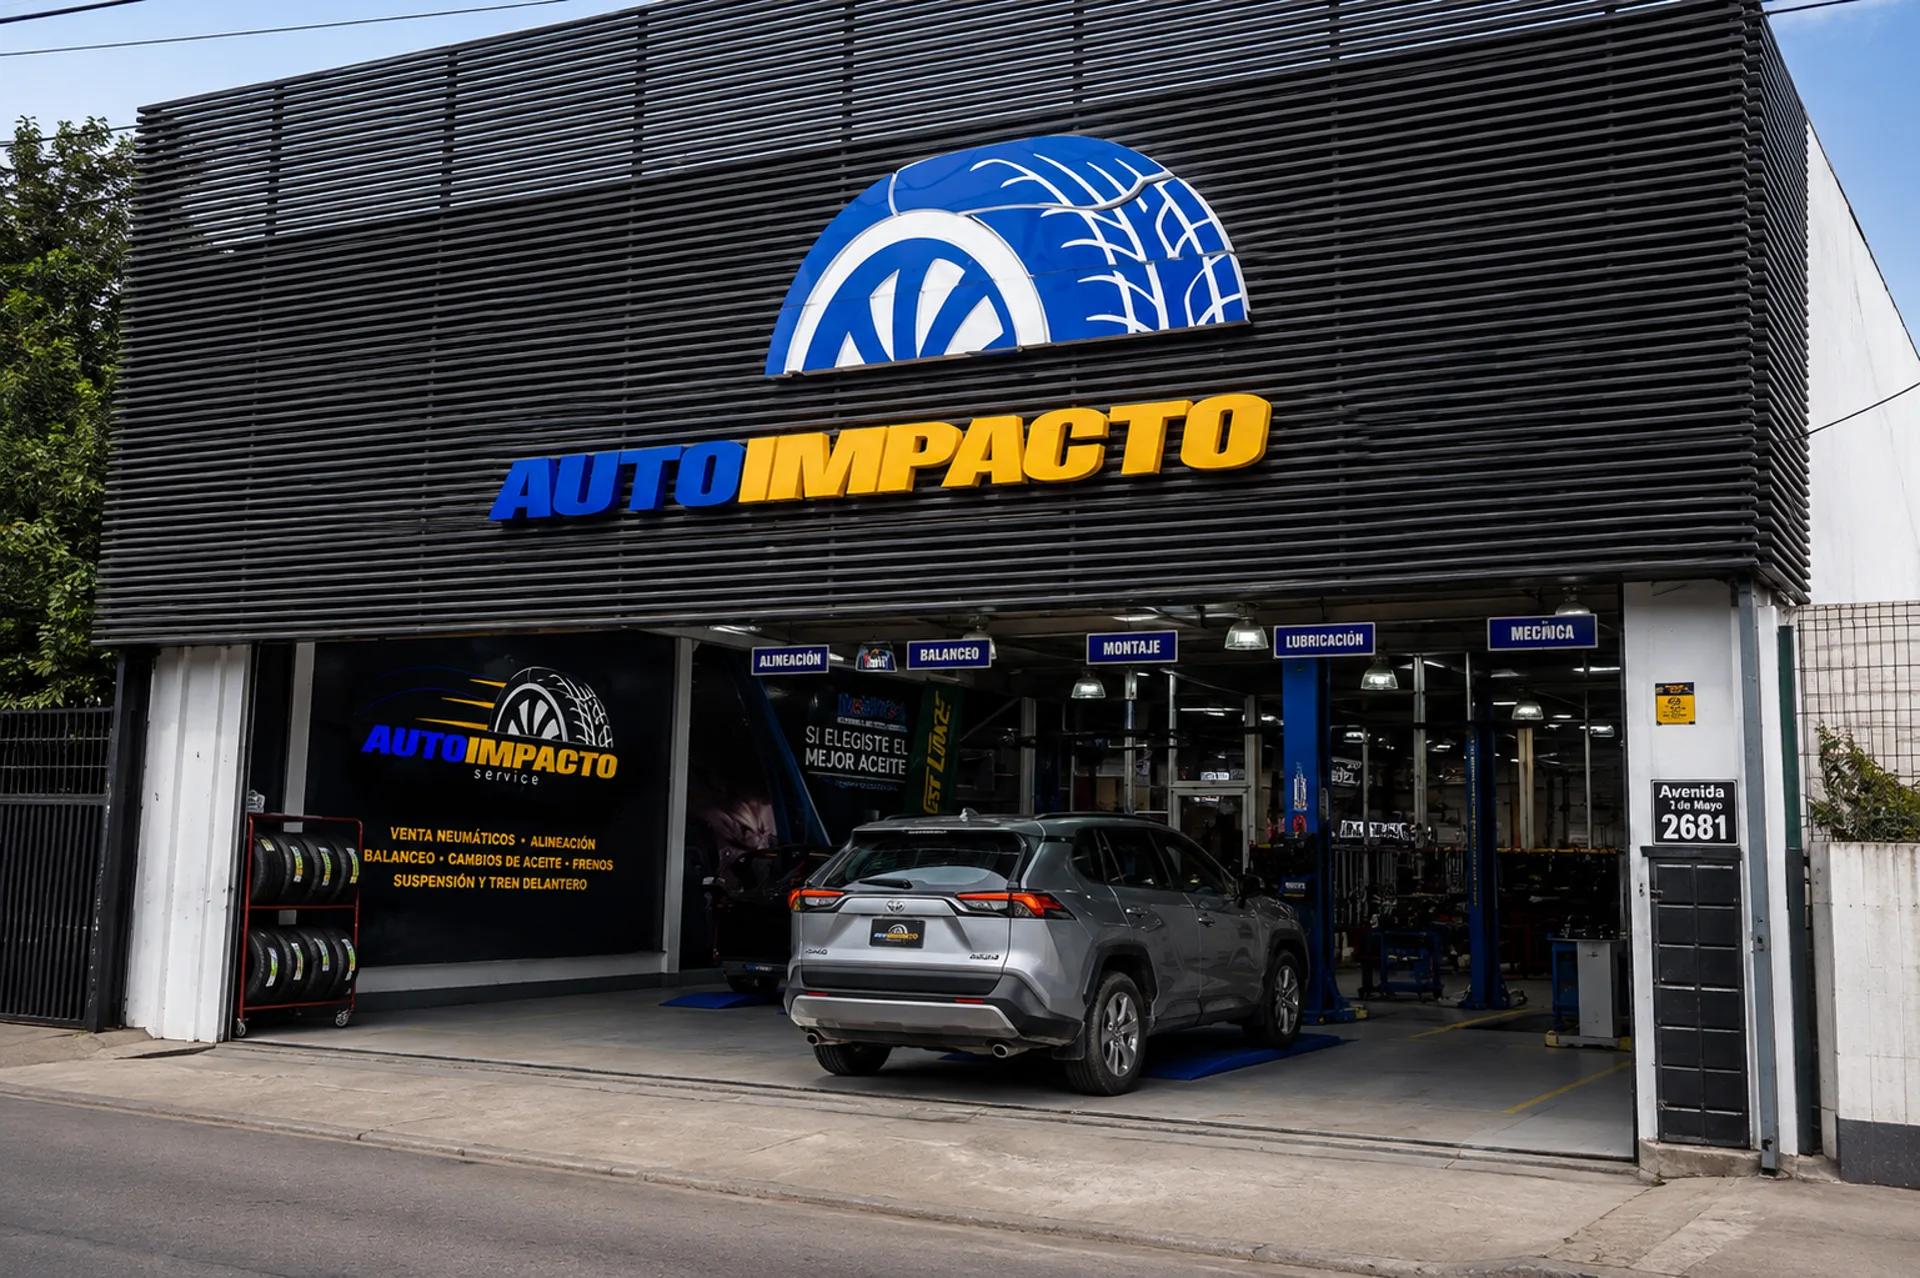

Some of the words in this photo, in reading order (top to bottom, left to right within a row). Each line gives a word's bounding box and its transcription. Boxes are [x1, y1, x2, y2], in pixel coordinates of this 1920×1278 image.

[489, 393, 1273, 522] AUTOIMPACTO
[920, 647, 980, 662] BALANCEO
[1103, 640, 1161, 656] MONTAJE
[759, 650, 822, 668] ALINEACIÓN
[805, 725, 820, 745] SI
[825, 728, 889, 753] ELEGISTE
[894, 738, 908, 755] EL
[361, 723, 619, 779] AUTOIMPACTO
[805, 747, 855, 770] MEJOR
[858, 754, 906, 775] ACEITE
[474, 769, 540, 785] service
[1659, 784, 1725, 799] Avenida
[1677, 800, 1691, 811] de
[1693, 800, 1723, 812] Mayo
[1661, 813, 1727, 840] 2681
[390, 826, 433, 842] VENTA
[436, 828, 516, 846] NEUMÁTICOS
[530, 835, 596, 850] ALINEACIÓN
[364, 849, 435, 865] BALANCEO
[448, 852, 502, 867] CAMBIOS
[505, 855, 521, 867] DE
[523, 856, 562, 869] ACEITE
[572, 858, 614, 871] FRENOS
[393, 873, 475, 889] SUSPENSIÓN
[478, 876, 487, 889] Y
[489, 876, 520, 889] TREN
[522, 877, 588, 891] DELANTERO
